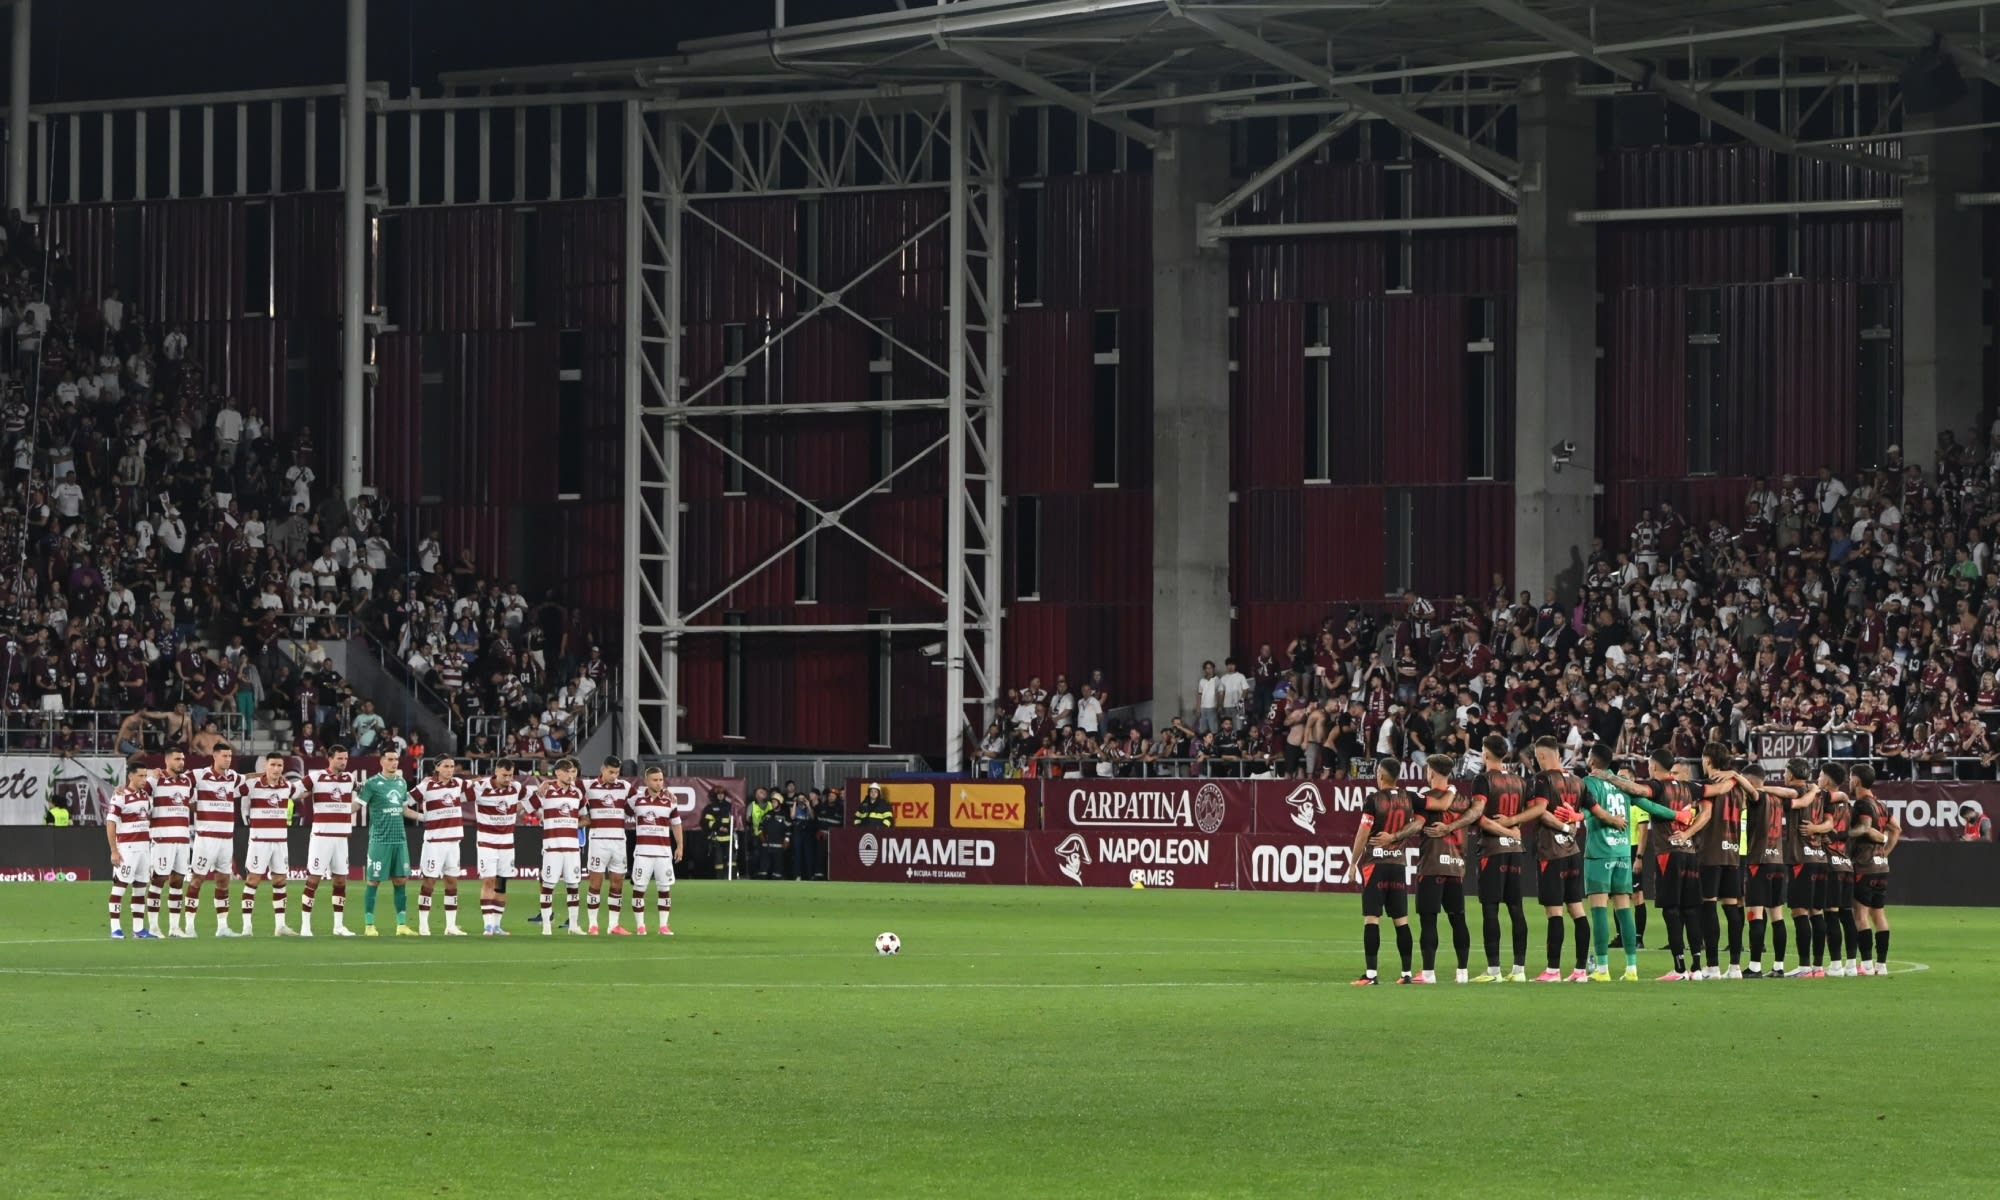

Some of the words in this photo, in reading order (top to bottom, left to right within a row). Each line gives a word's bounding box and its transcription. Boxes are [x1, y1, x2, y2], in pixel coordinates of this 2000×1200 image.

[1069, 788, 1194, 827] CARPATINA
[881, 838, 995, 867] IMAMED
[1099, 838, 1209, 865] NAPOLEON
[197, 856, 207, 867] 22
[314, 858, 320, 867] 6
[372, 861, 382, 871] 16
